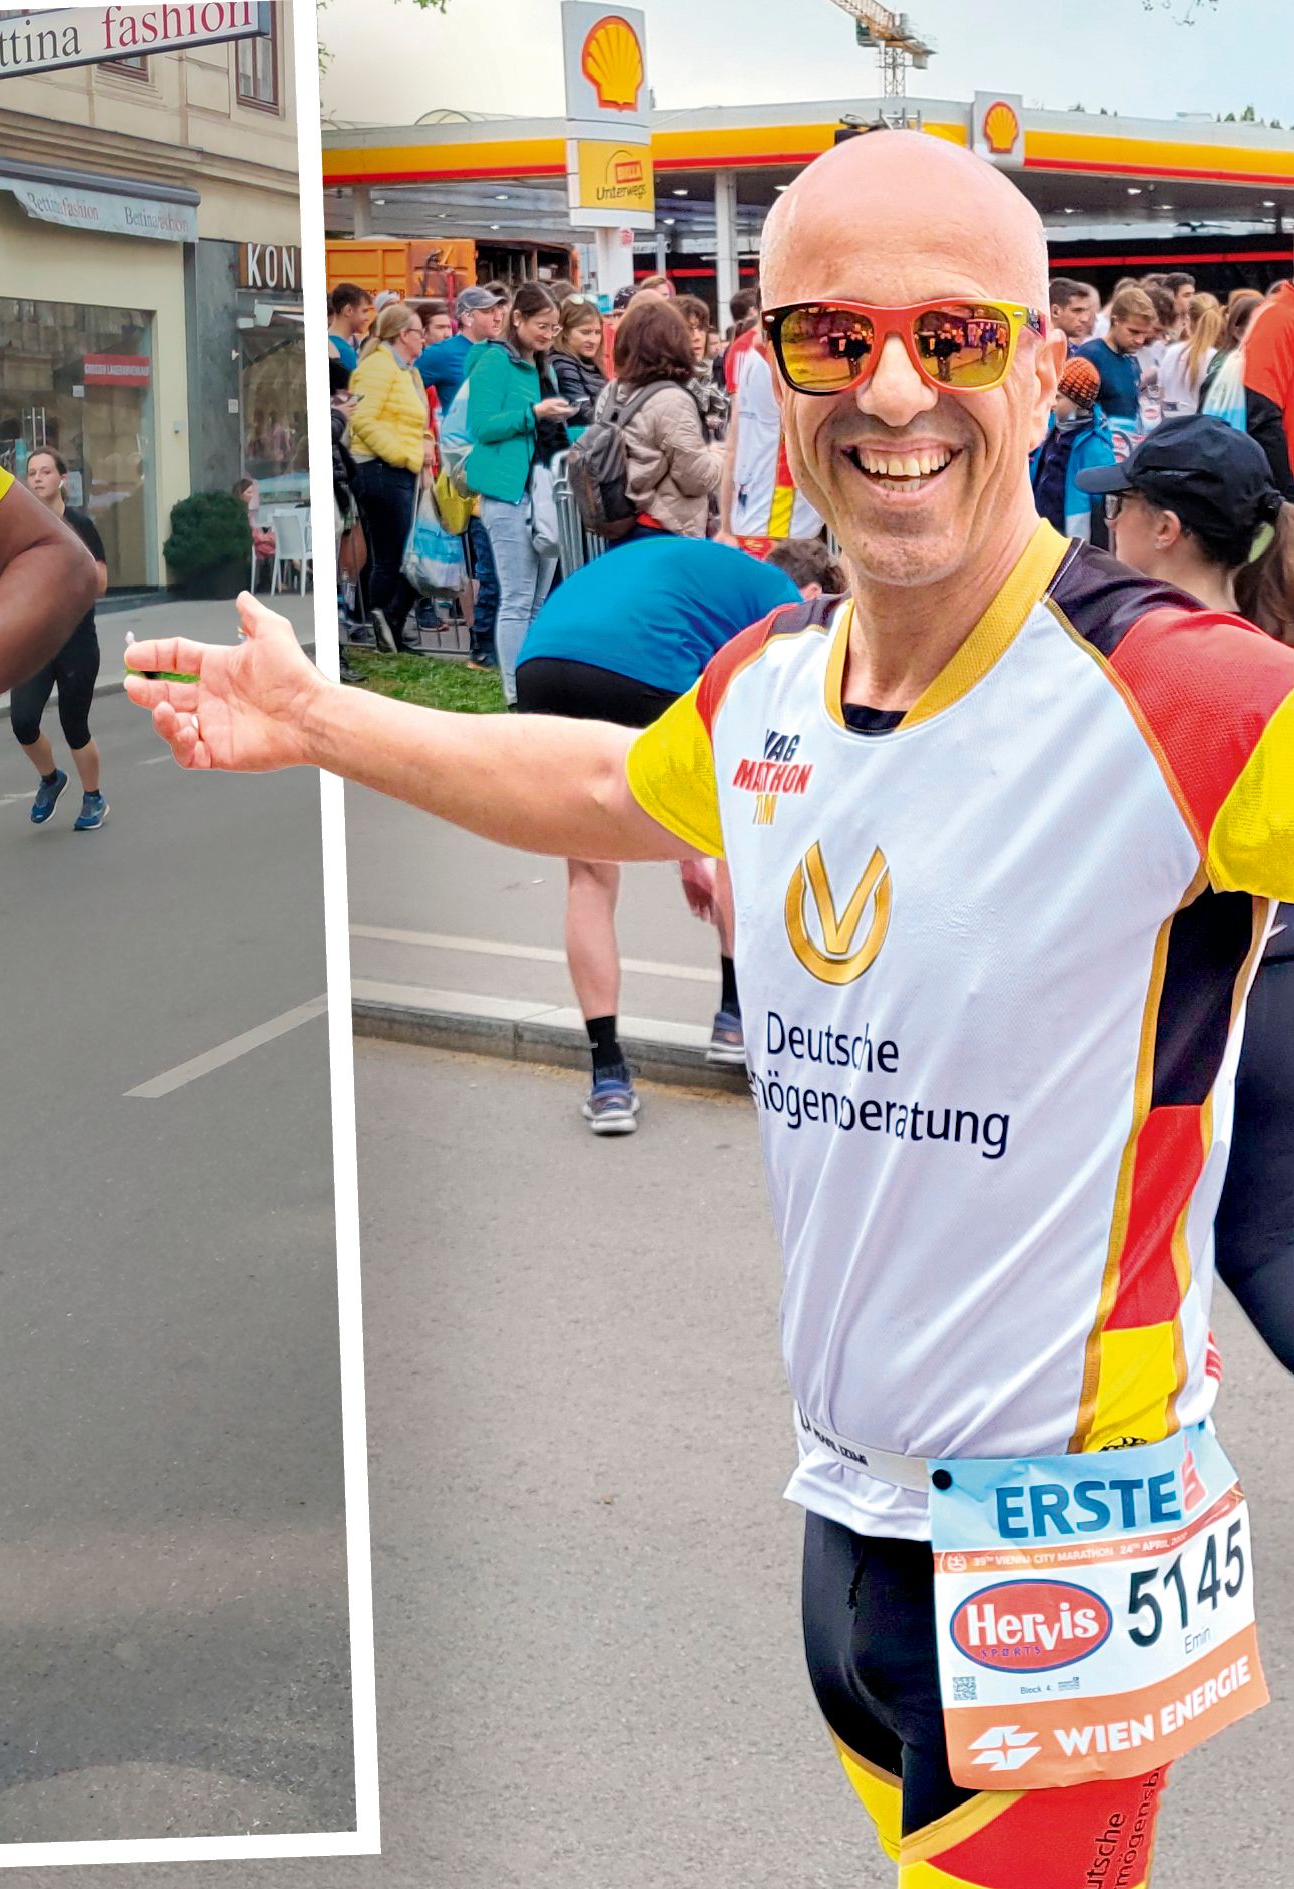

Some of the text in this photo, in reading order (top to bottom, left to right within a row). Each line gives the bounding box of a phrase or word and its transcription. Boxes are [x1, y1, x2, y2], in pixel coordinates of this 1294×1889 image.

[100, 2, 253, 50] fashion
[763, 728, 801, 762] VAG
[766, 1010, 899, 1073] Deutsche
[995, 1470, 1182, 1539] ERSTE
[1033, 1553, 1055, 1564] CITY
[1057, 1547, 1115, 1561] MARATHON
[1142, 1540, 1170, 1552] APRIL
[966, 1518, 1245, 1651] Hervis 5145
[981, 1646, 1042, 1659] SPORTS
[1185, 1627, 1211, 1655] Emin
[1020, 1686, 1042, 1695] Block
[1053, 1655, 1251, 1757] WIEN ENERGIE
[1086, 1813, 1126, 1889] utsche
